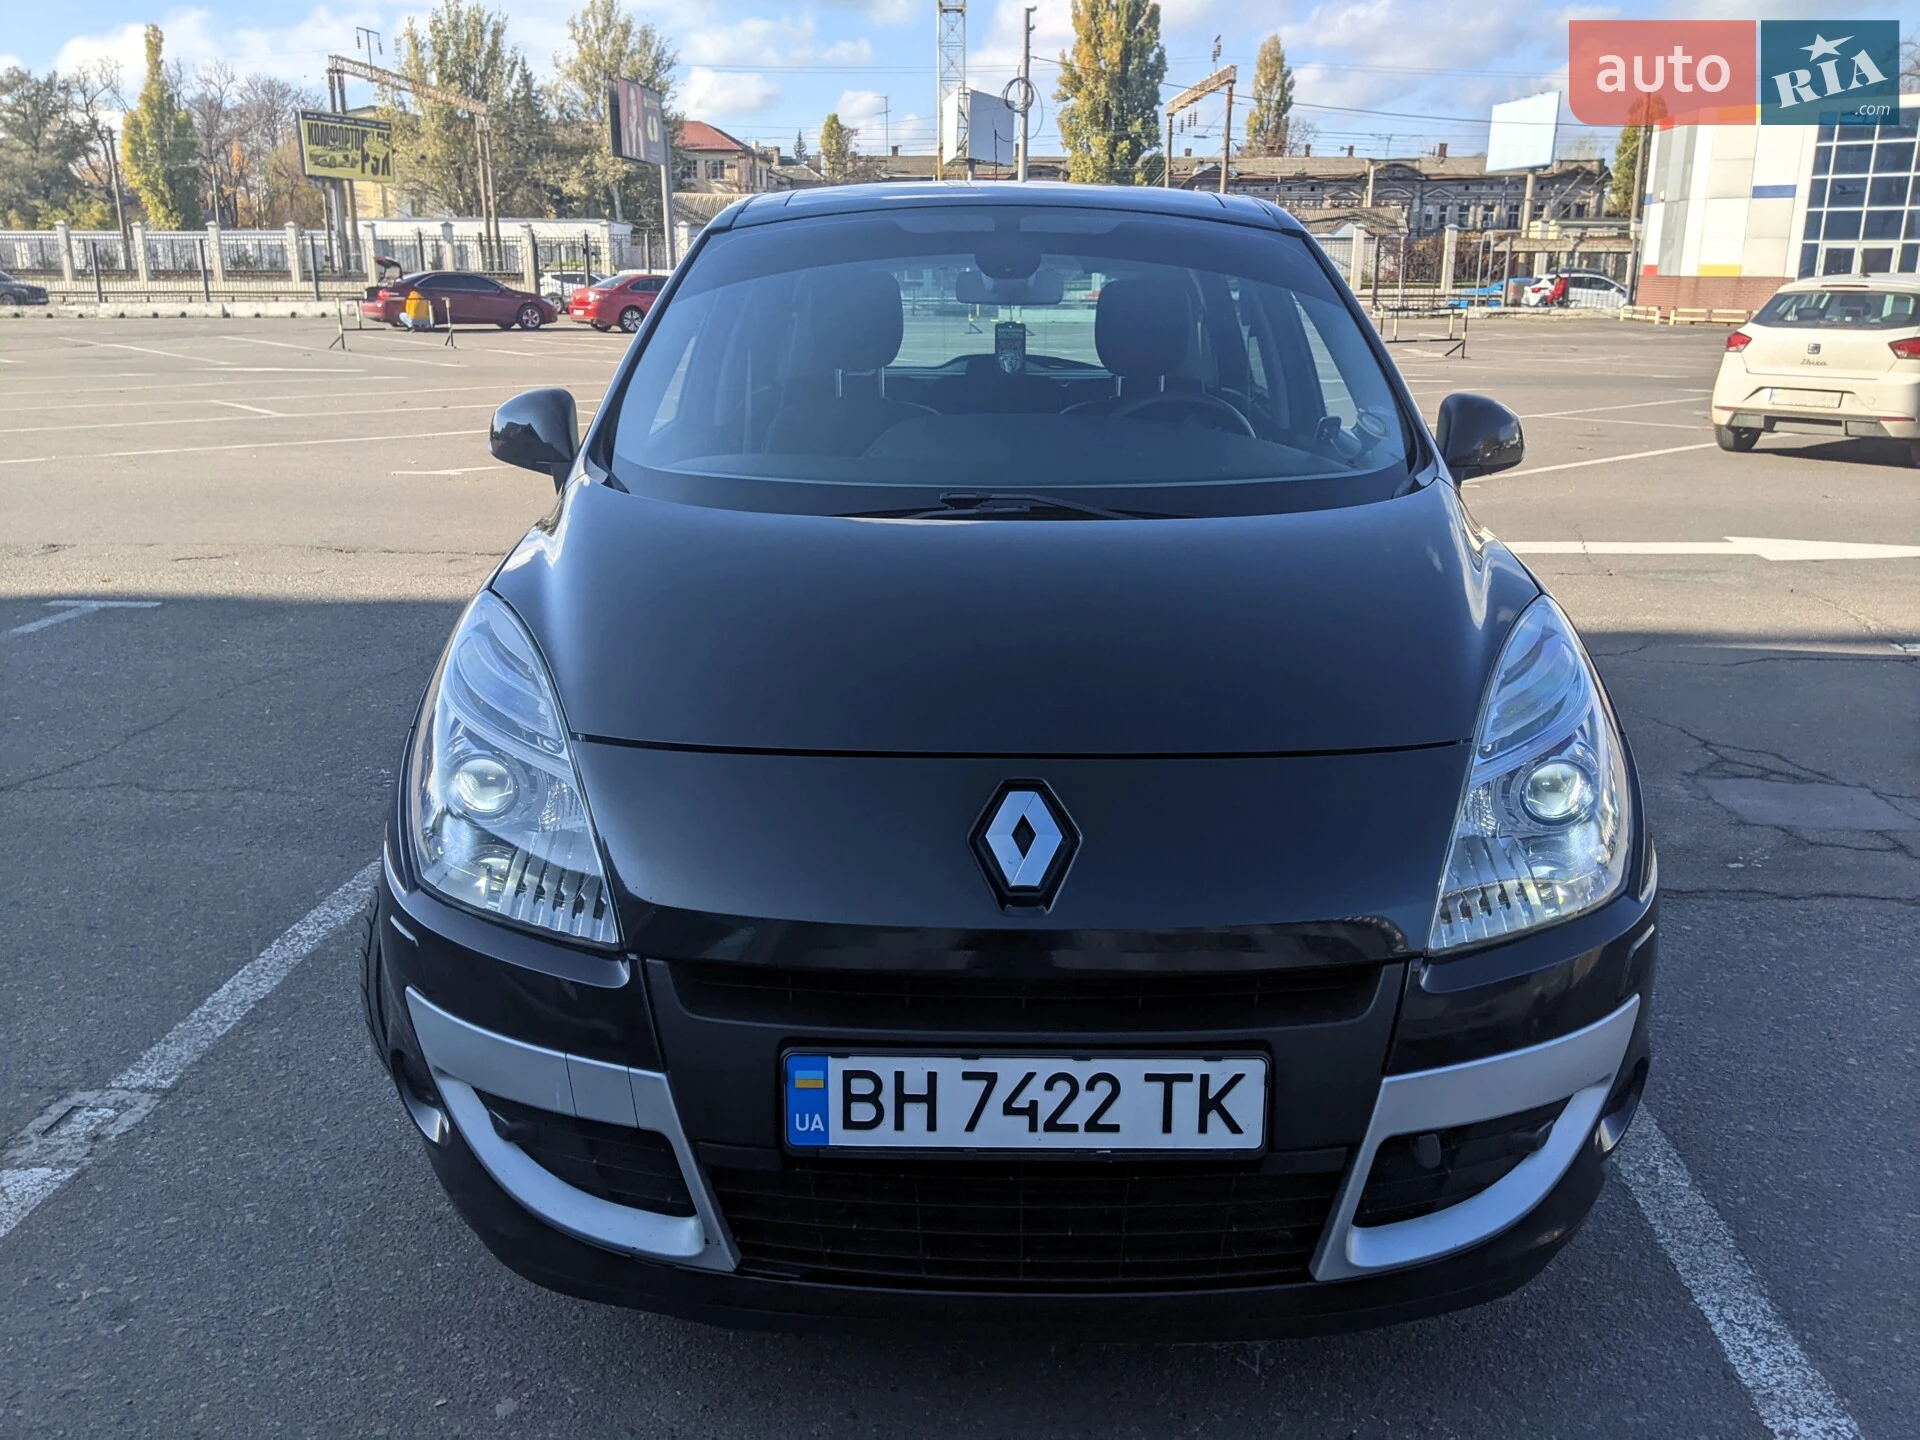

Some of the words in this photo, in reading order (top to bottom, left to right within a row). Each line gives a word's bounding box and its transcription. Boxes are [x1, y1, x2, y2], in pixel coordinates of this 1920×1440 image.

[794, 1113, 825, 1132] UA
[841, 1069, 938, 1133] BH
[960, 1071, 1122, 1133] 7422
[1143, 1072, 1246, 1135] TK
